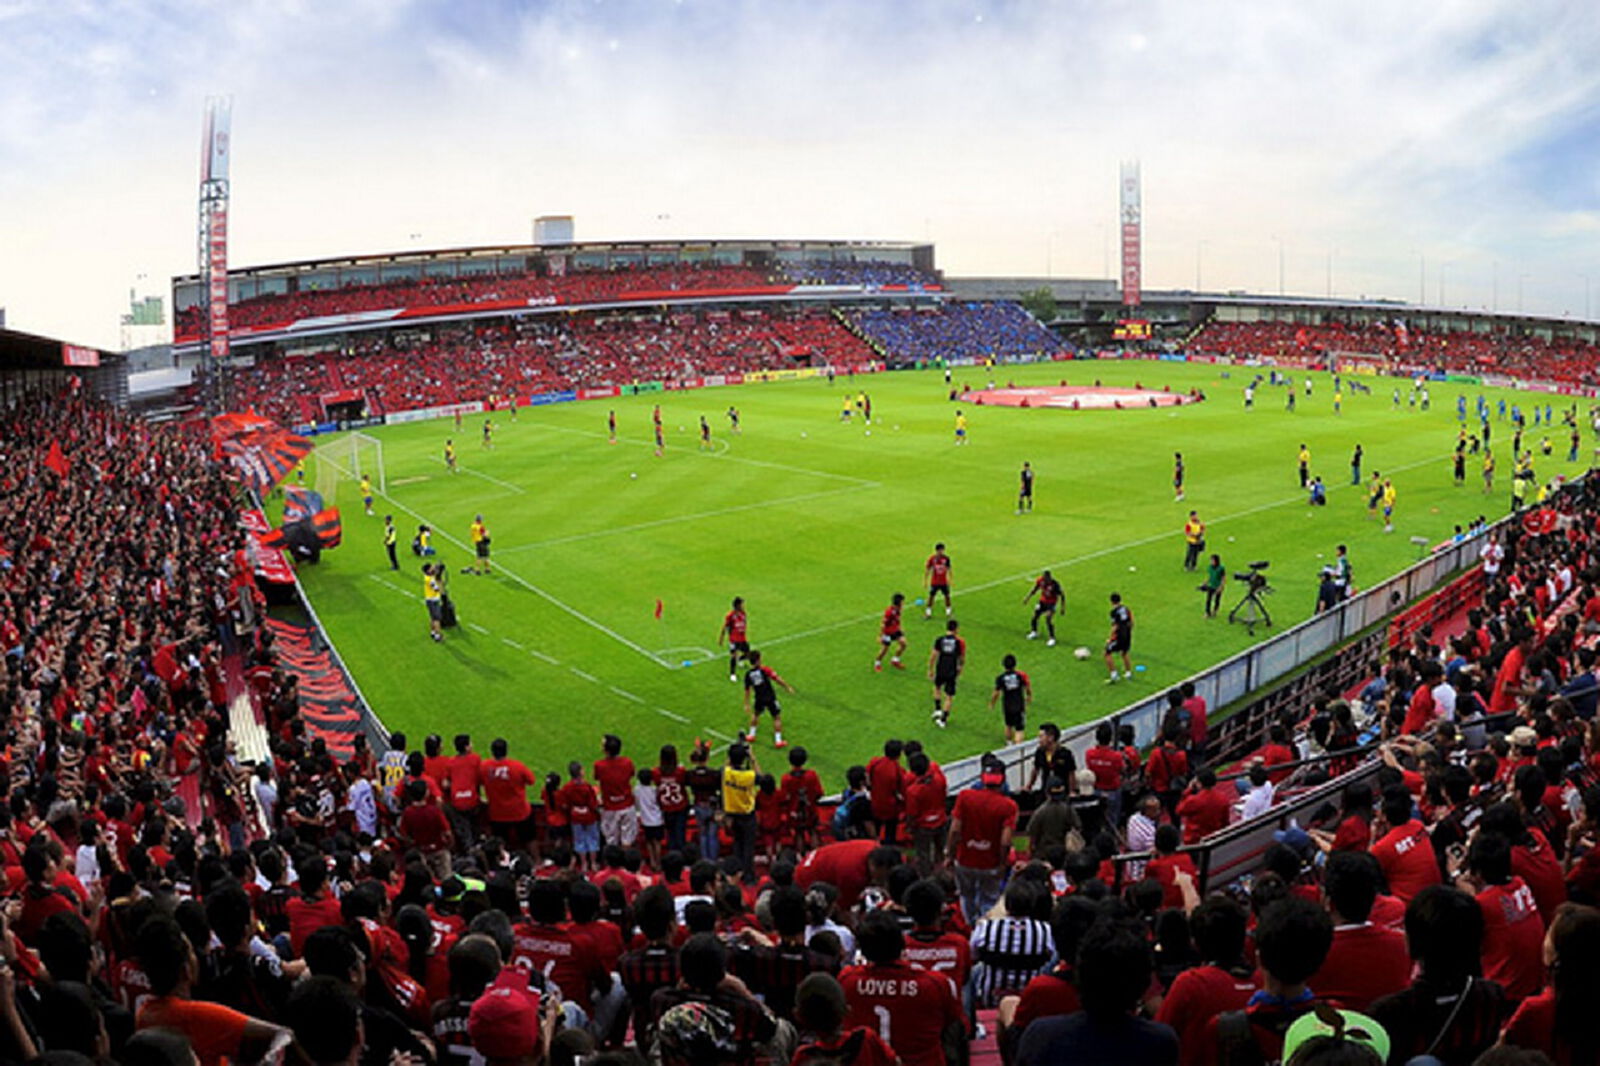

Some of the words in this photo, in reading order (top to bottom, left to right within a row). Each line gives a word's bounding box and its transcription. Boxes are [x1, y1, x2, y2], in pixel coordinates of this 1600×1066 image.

[658, 784, 683, 805] 23
[857, 979, 897, 996] LOVE
[901, 979, 918, 996] IS
